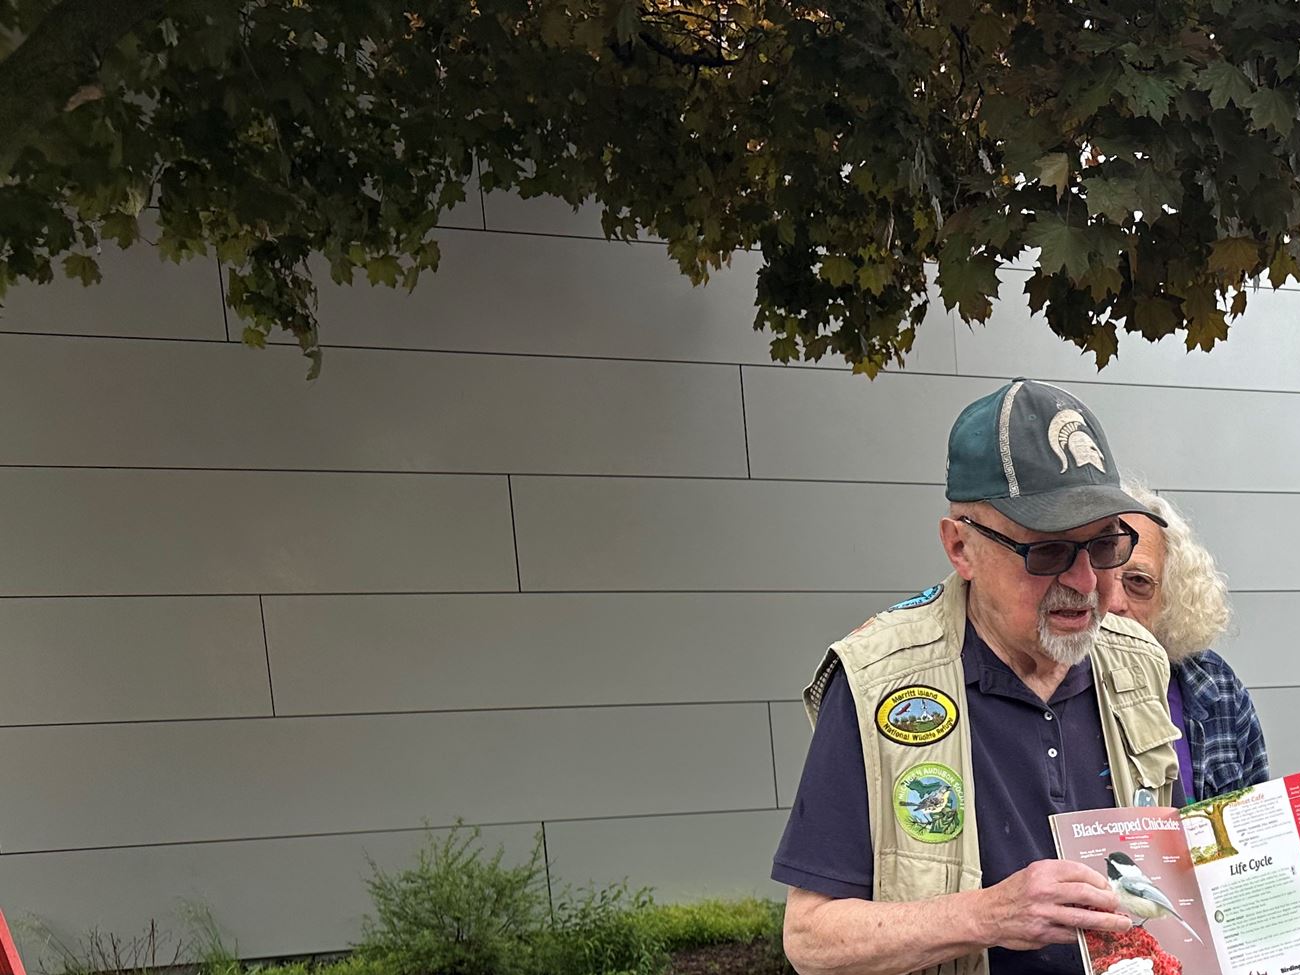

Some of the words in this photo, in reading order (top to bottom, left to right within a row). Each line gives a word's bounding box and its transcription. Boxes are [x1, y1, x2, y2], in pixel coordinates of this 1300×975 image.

[892, 690, 916, 704] Merritt
[917, 689, 938, 700] Island
[883, 723, 910, 741] National
[923, 767, 955, 783] AUDUBON
[1072, 818, 1141, 838] Black-capped
[1230, 862, 1248, 876] Life
[1248, 855, 1273, 871] Cycle
